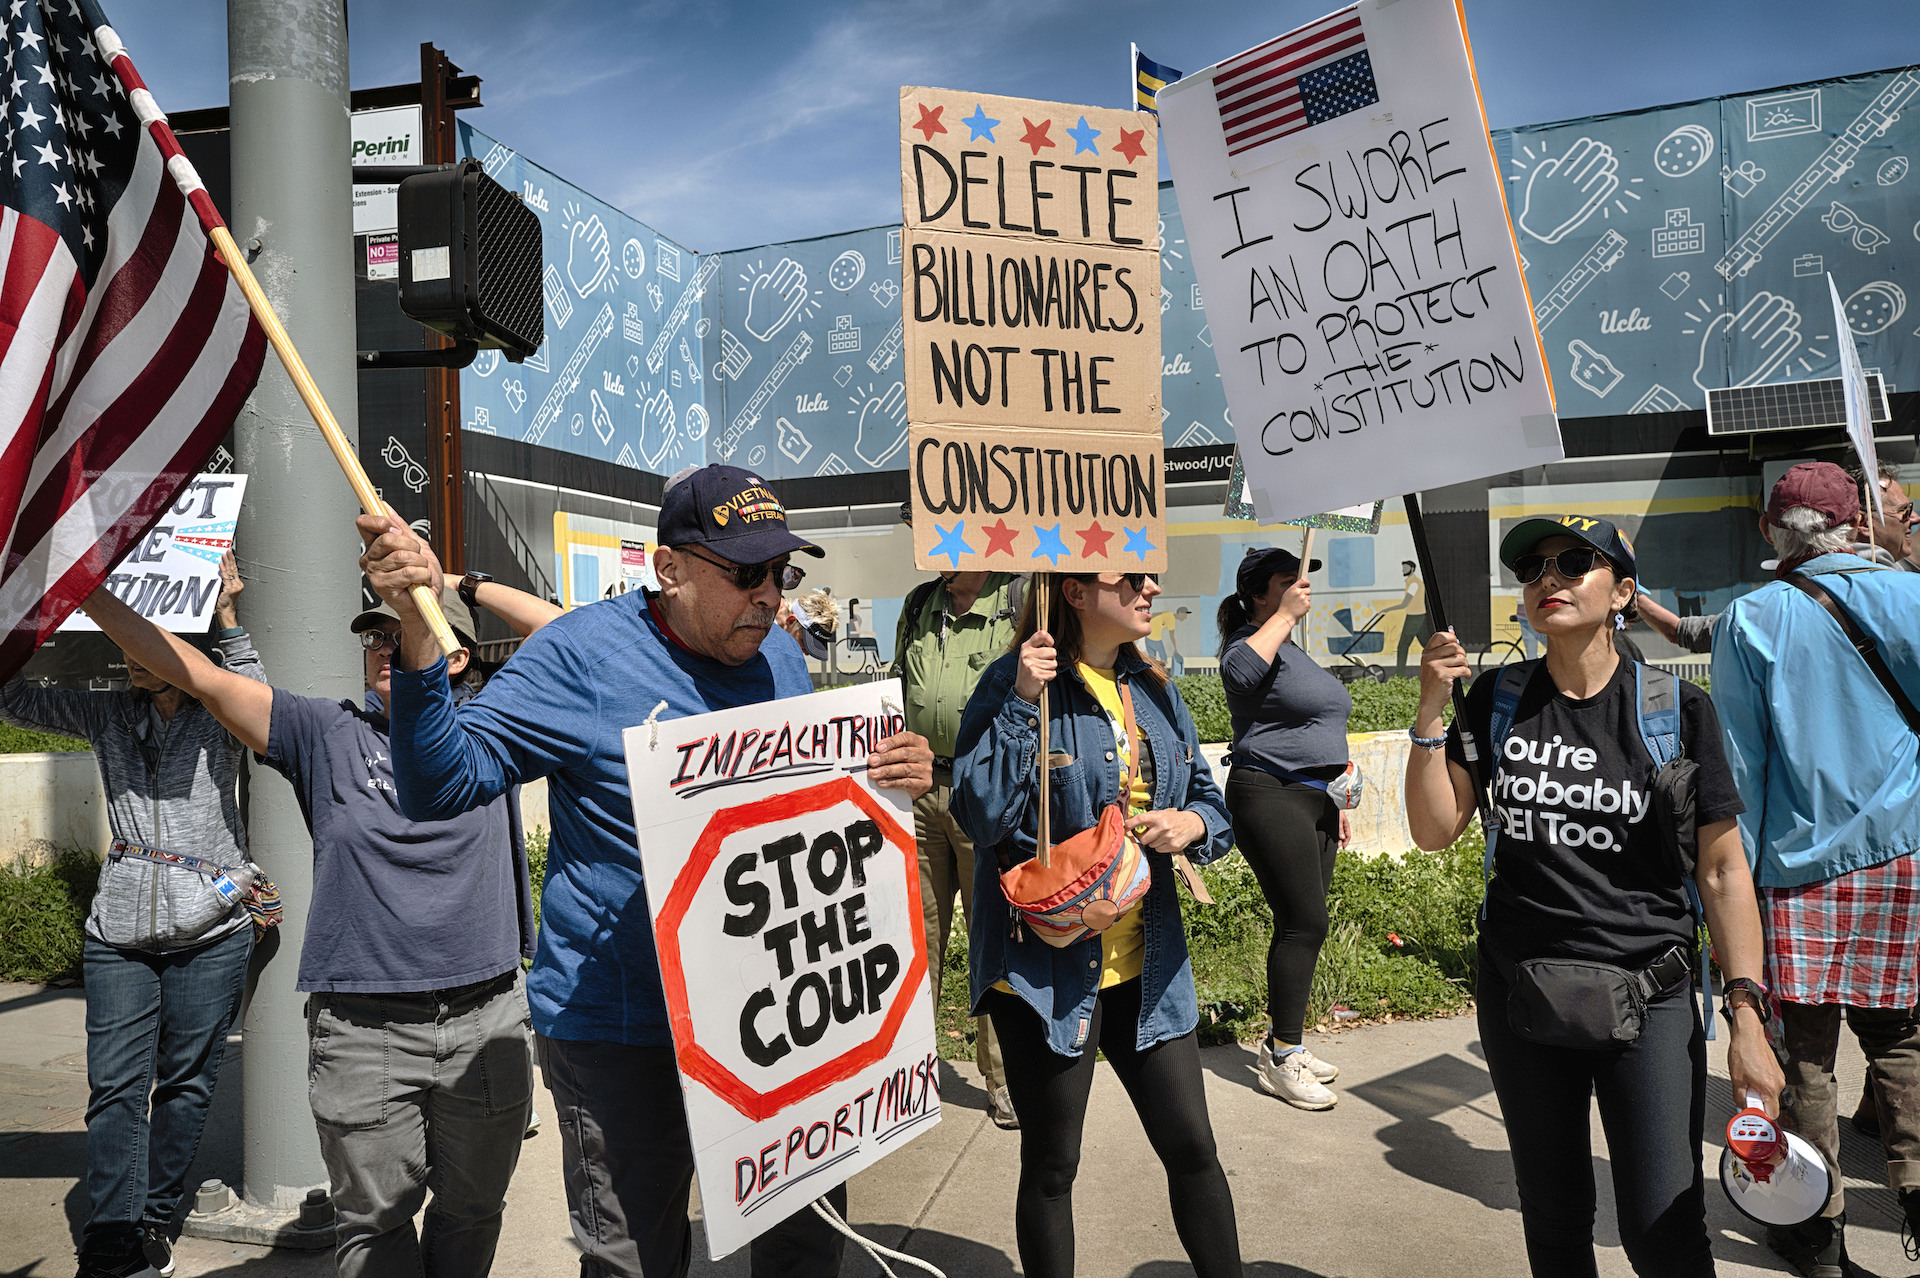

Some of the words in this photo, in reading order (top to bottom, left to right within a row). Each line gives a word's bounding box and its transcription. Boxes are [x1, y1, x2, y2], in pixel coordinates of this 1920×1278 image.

[352, 134, 410, 158] Perini
[355, 188, 382, 198] Extension
[523, 180, 549, 213] Ucla
[912, 144, 1143, 245] DELETE
[1213, 186, 1273, 260] I
[1293, 117, 1466, 232] SWORE
[370, 235, 390, 244] Private
[370, 246, 385, 258] NO
[1250, 254, 1307, 322] AN
[1324, 198, 1467, 302] OATH
[912, 243, 1144, 335] BILLIONAIRES,
[1240, 333, 1307, 385] TO
[1316, 265, 1497, 364] PROTECT
[1599, 307, 1652, 334] Ucla
[603, 370, 625, 396] Ucla
[796, 392, 829, 413] Ucla
[931, 339, 1020, 408] NOT
[1031, 349, 1121, 415] THE
[1261, 336, 1524, 456] CONSTITUTION
[916, 438, 1157, 518] CONSTITUTION
[1556, 515, 1599, 532] VY
[669, 720, 828, 789] IMPEACH
[1504, 728, 1598, 772] ou're
[1540, 811, 1622, 853] Too.
[723, 820, 884, 938] STOP
[763, 893, 872, 981] THE
[740, 943, 900, 1068] COUP
[735, 1087, 875, 1207] DEPORT
[872, 1052, 941, 1133] MUSK
